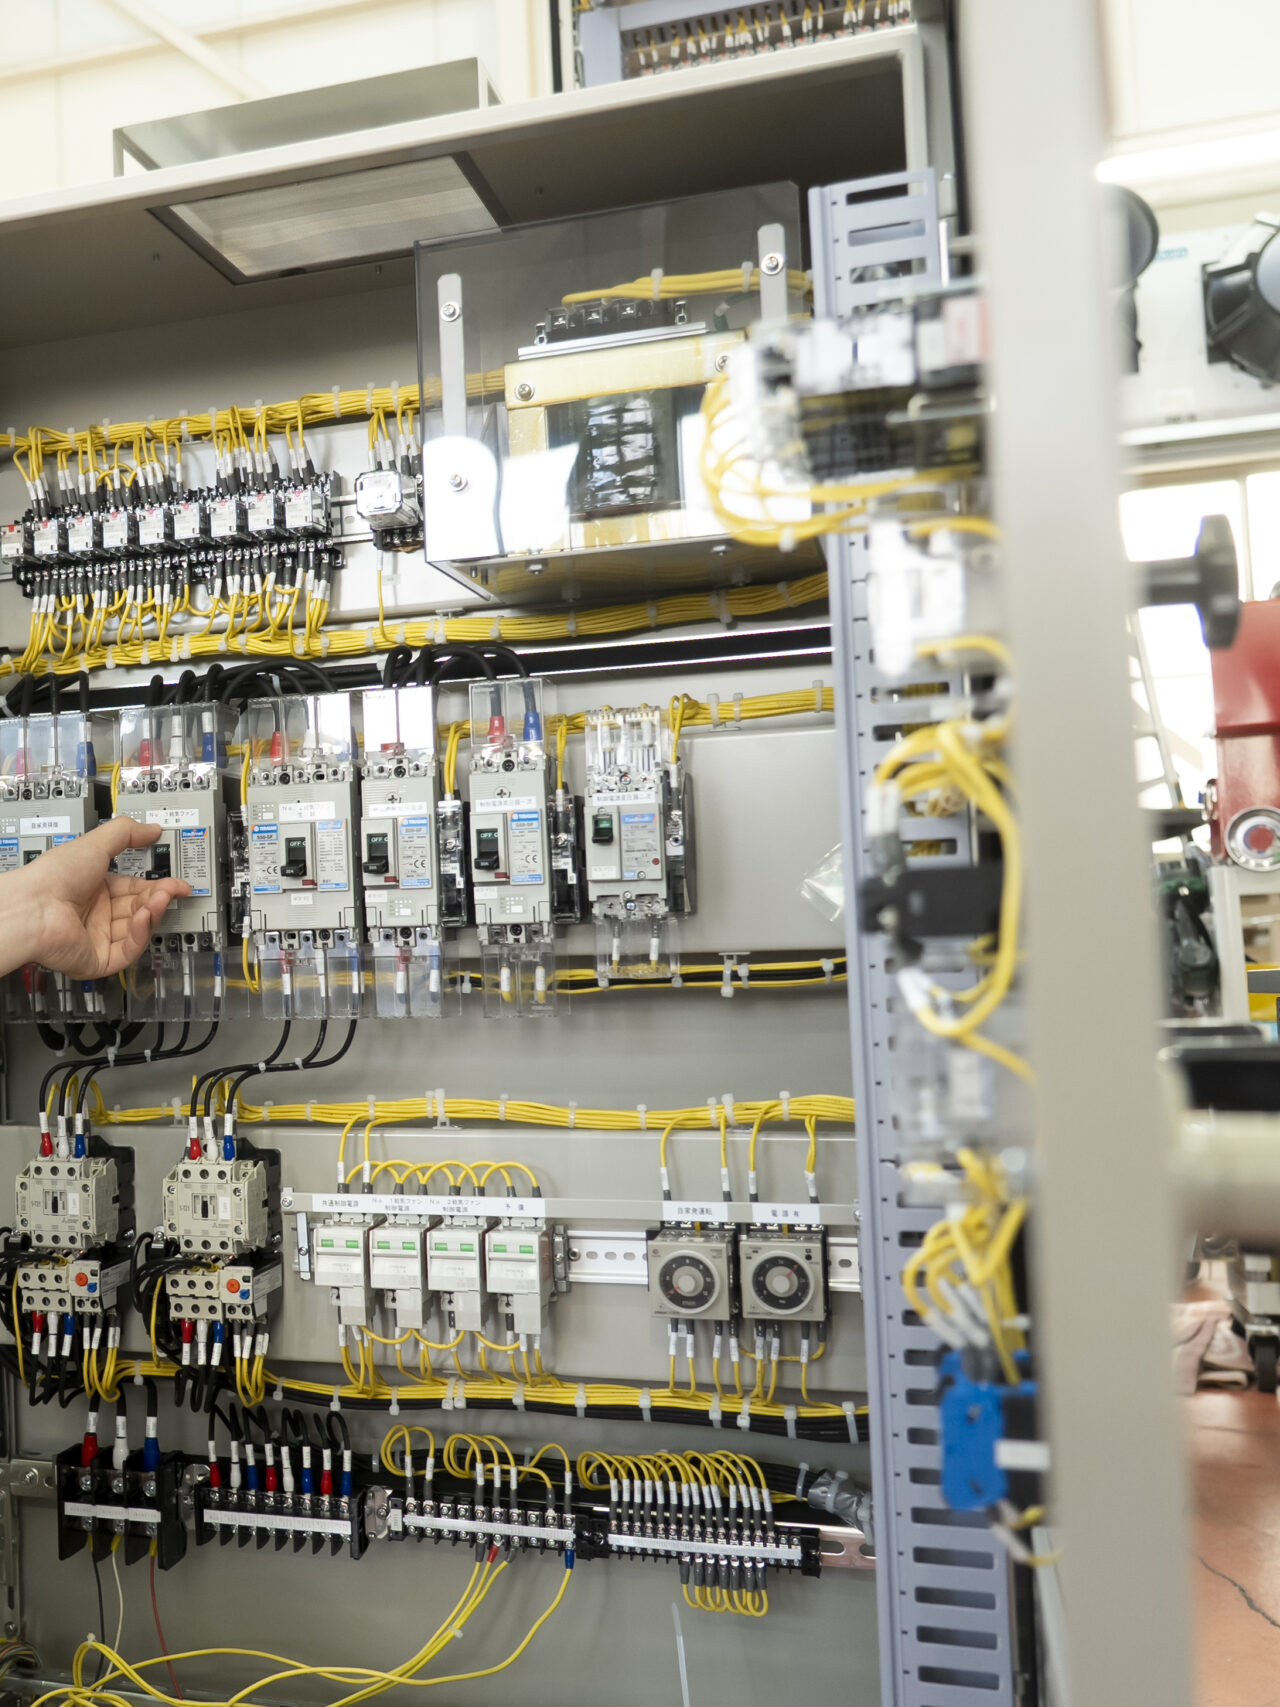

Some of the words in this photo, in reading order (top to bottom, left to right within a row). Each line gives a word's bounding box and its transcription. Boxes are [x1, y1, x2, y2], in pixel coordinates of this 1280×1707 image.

[524, 854, 538, 863] CE
[413, 859, 426, 868] CE
[266, 865, 278, 875] CE
